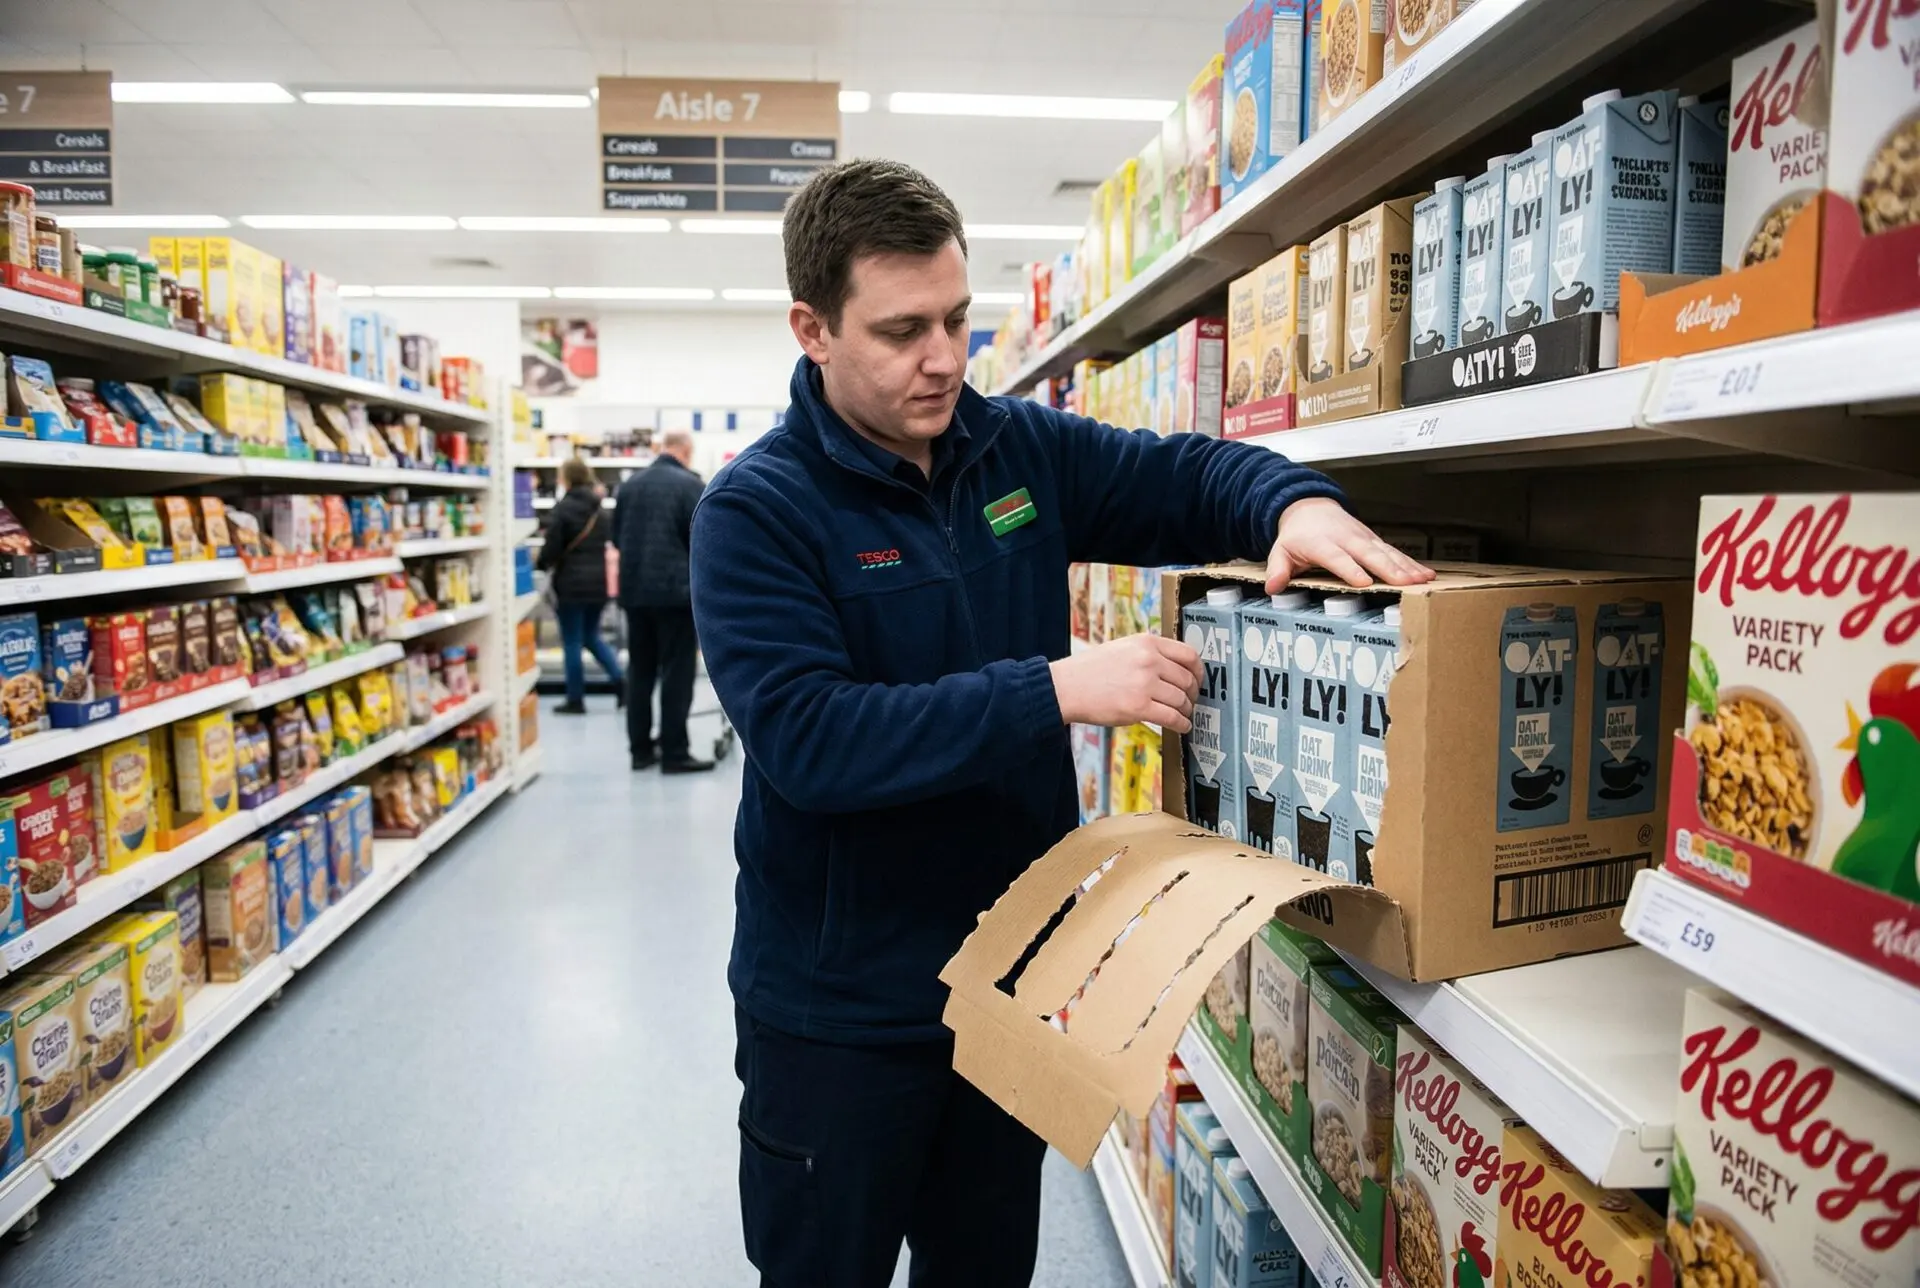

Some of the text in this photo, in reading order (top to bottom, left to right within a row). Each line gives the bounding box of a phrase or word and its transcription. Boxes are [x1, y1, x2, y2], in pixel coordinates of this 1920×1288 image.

[16, 85, 37, 113] 7
[654, 91, 762, 122] Aisle 7
[55, 133, 104, 148] Cereals
[1555, 124, 1601, 178] OAT-
[29, 159, 106, 175] & Breakfast
[1507, 157, 1549, 207] OAT-
[1464, 182, 1500, 227] OAT-
[1560, 168, 1593, 216] LY!
[1413, 204, 1449, 245] OAT-
[1512, 197, 1542, 240] LY!
[1418, 238, 1443, 276] LY!
[1467, 219, 1494, 259] LY!
[1353, 257, 1375, 293] LY!
[1390, 252, 1411, 265] no
[1313, 275, 1333, 309] LY!
[1676, 292, 1742, 333] Kellogg's
[1452, 345, 1505, 388] OATY!
[856, 549, 900, 565] TESCO
[1185, 623, 1232, 664] OAT-
[1243, 626, 1293, 670] OAT-
[1732, 614, 1825, 648] VARIETY
[1294, 634, 1352, 681] OAT-
[1505, 638, 1573, 675] OAT-
[1597, 632, 1660, 668] OAT-
[1746, 643, 1803, 675] PACK
[1252, 666, 1289, 711] LY!
[1303, 678, 1347, 725] LY!
[1516, 673, 1564, 709] LY!
[1606, 667, 1651, 701] LY!
[1195, 712, 1211, 731] OAT
[1251, 720, 1268, 740] OAT
[1518, 719, 1539, 733] OAT
[1607, 724, 1634, 738] DRINK
[1608, 711, 1627, 725] OAT
[1195, 728, 1219, 751] DRINK
[1250, 738, 1276, 761] DRINK
[1301, 734, 1322, 756] OAT
[1517, 732, 1548, 747] DRINK
[1300, 754, 1331, 780] DRINK
[1361, 754, 1384, 778] OAT
[1680, 921, 1715, 952] £59
[1396, 1051, 1502, 1196] Kellogg
[1408, 1118, 1449, 1170] VARIETY
[1415, 1145, 1441, 1186] PACK
[1710, 1128, 1799, 1205] VARIETY
[1721, 1166, 1776, 1223] PACK
